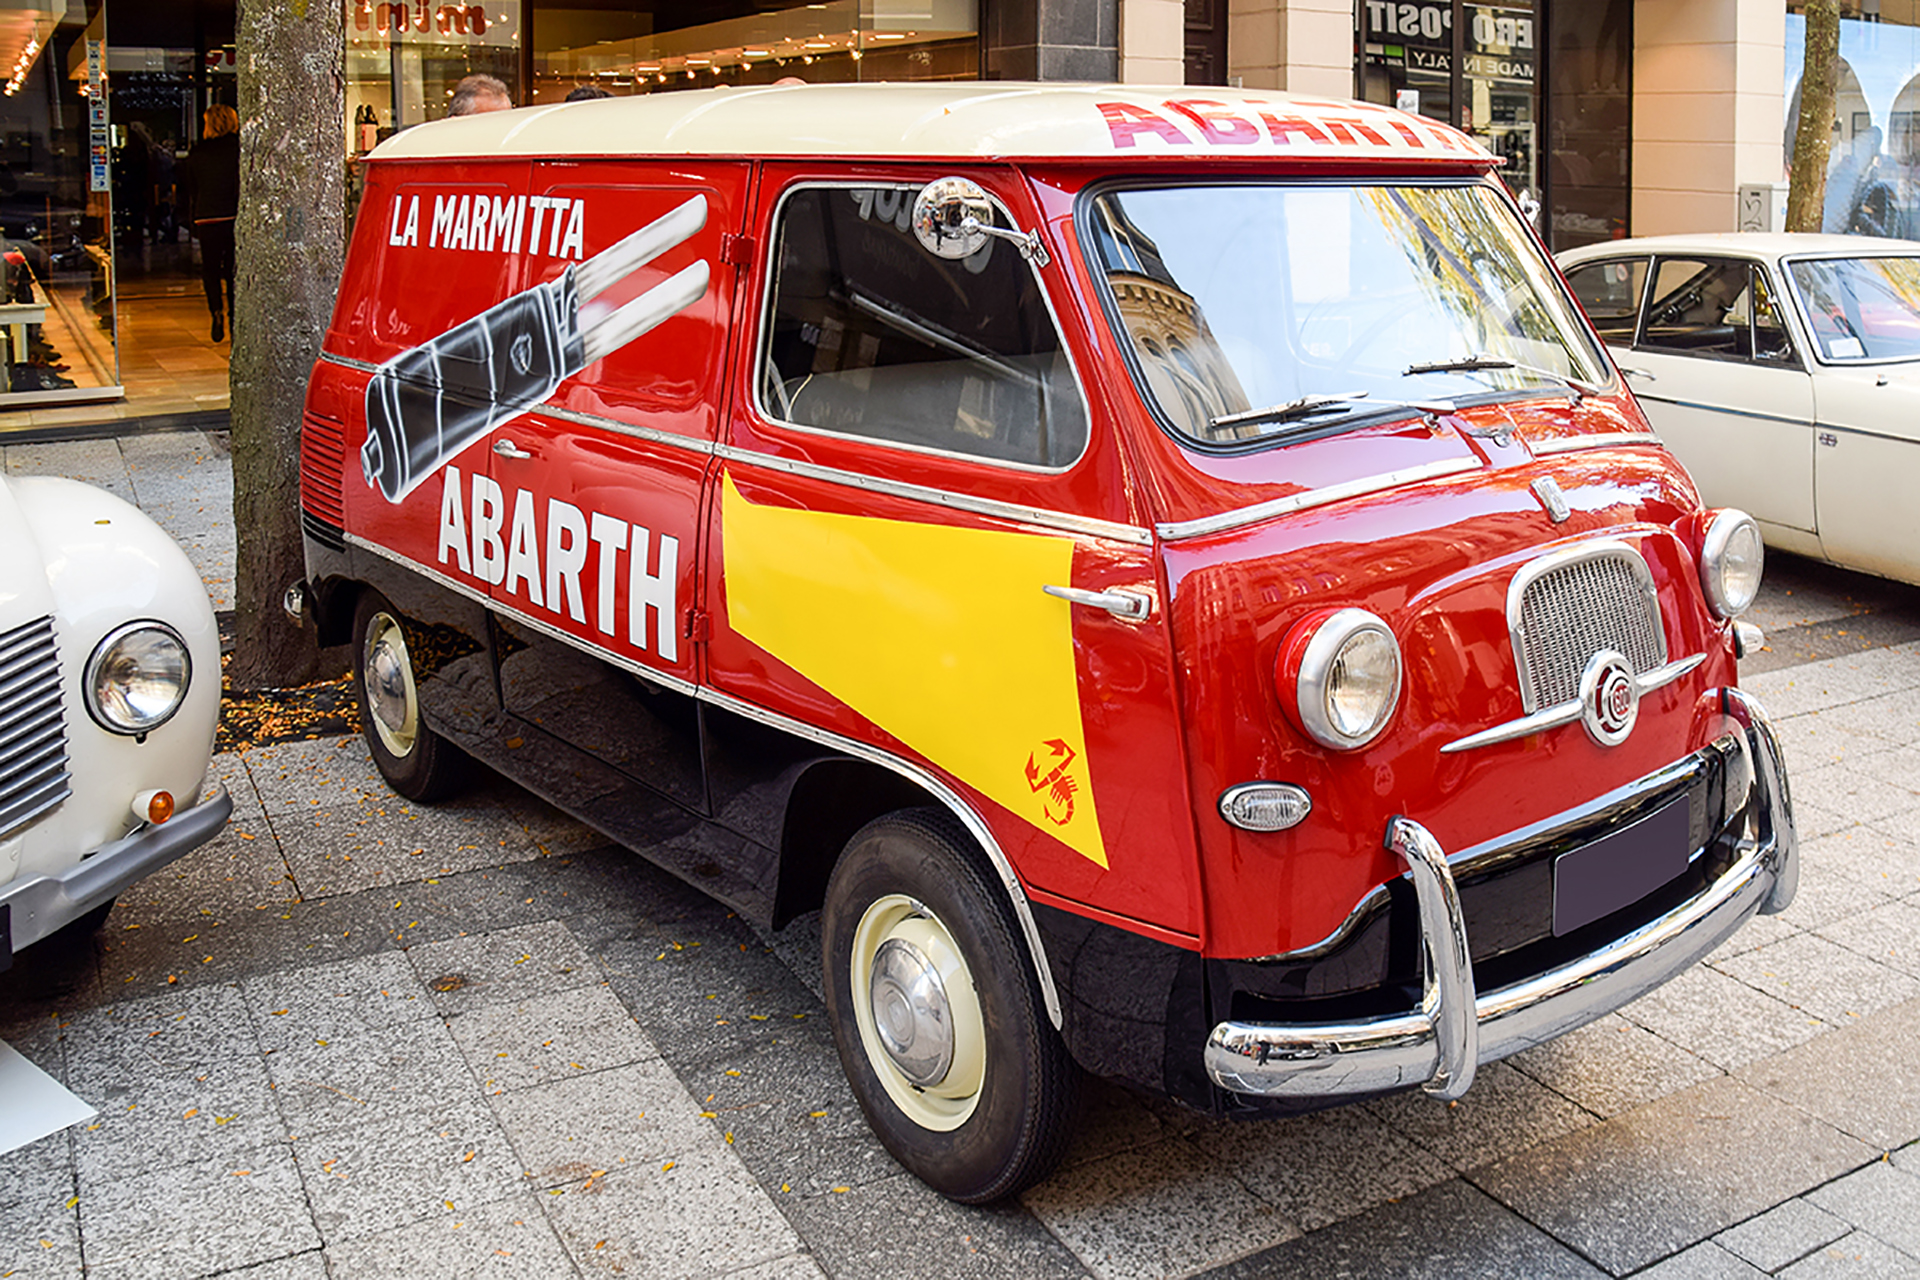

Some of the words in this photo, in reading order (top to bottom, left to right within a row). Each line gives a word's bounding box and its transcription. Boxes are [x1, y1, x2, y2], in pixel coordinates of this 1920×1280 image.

[389, 195, 420, 248] LA
[429, 194, 585, 261] MARMITTA
[437, 464, 680, 664] ABARTH
